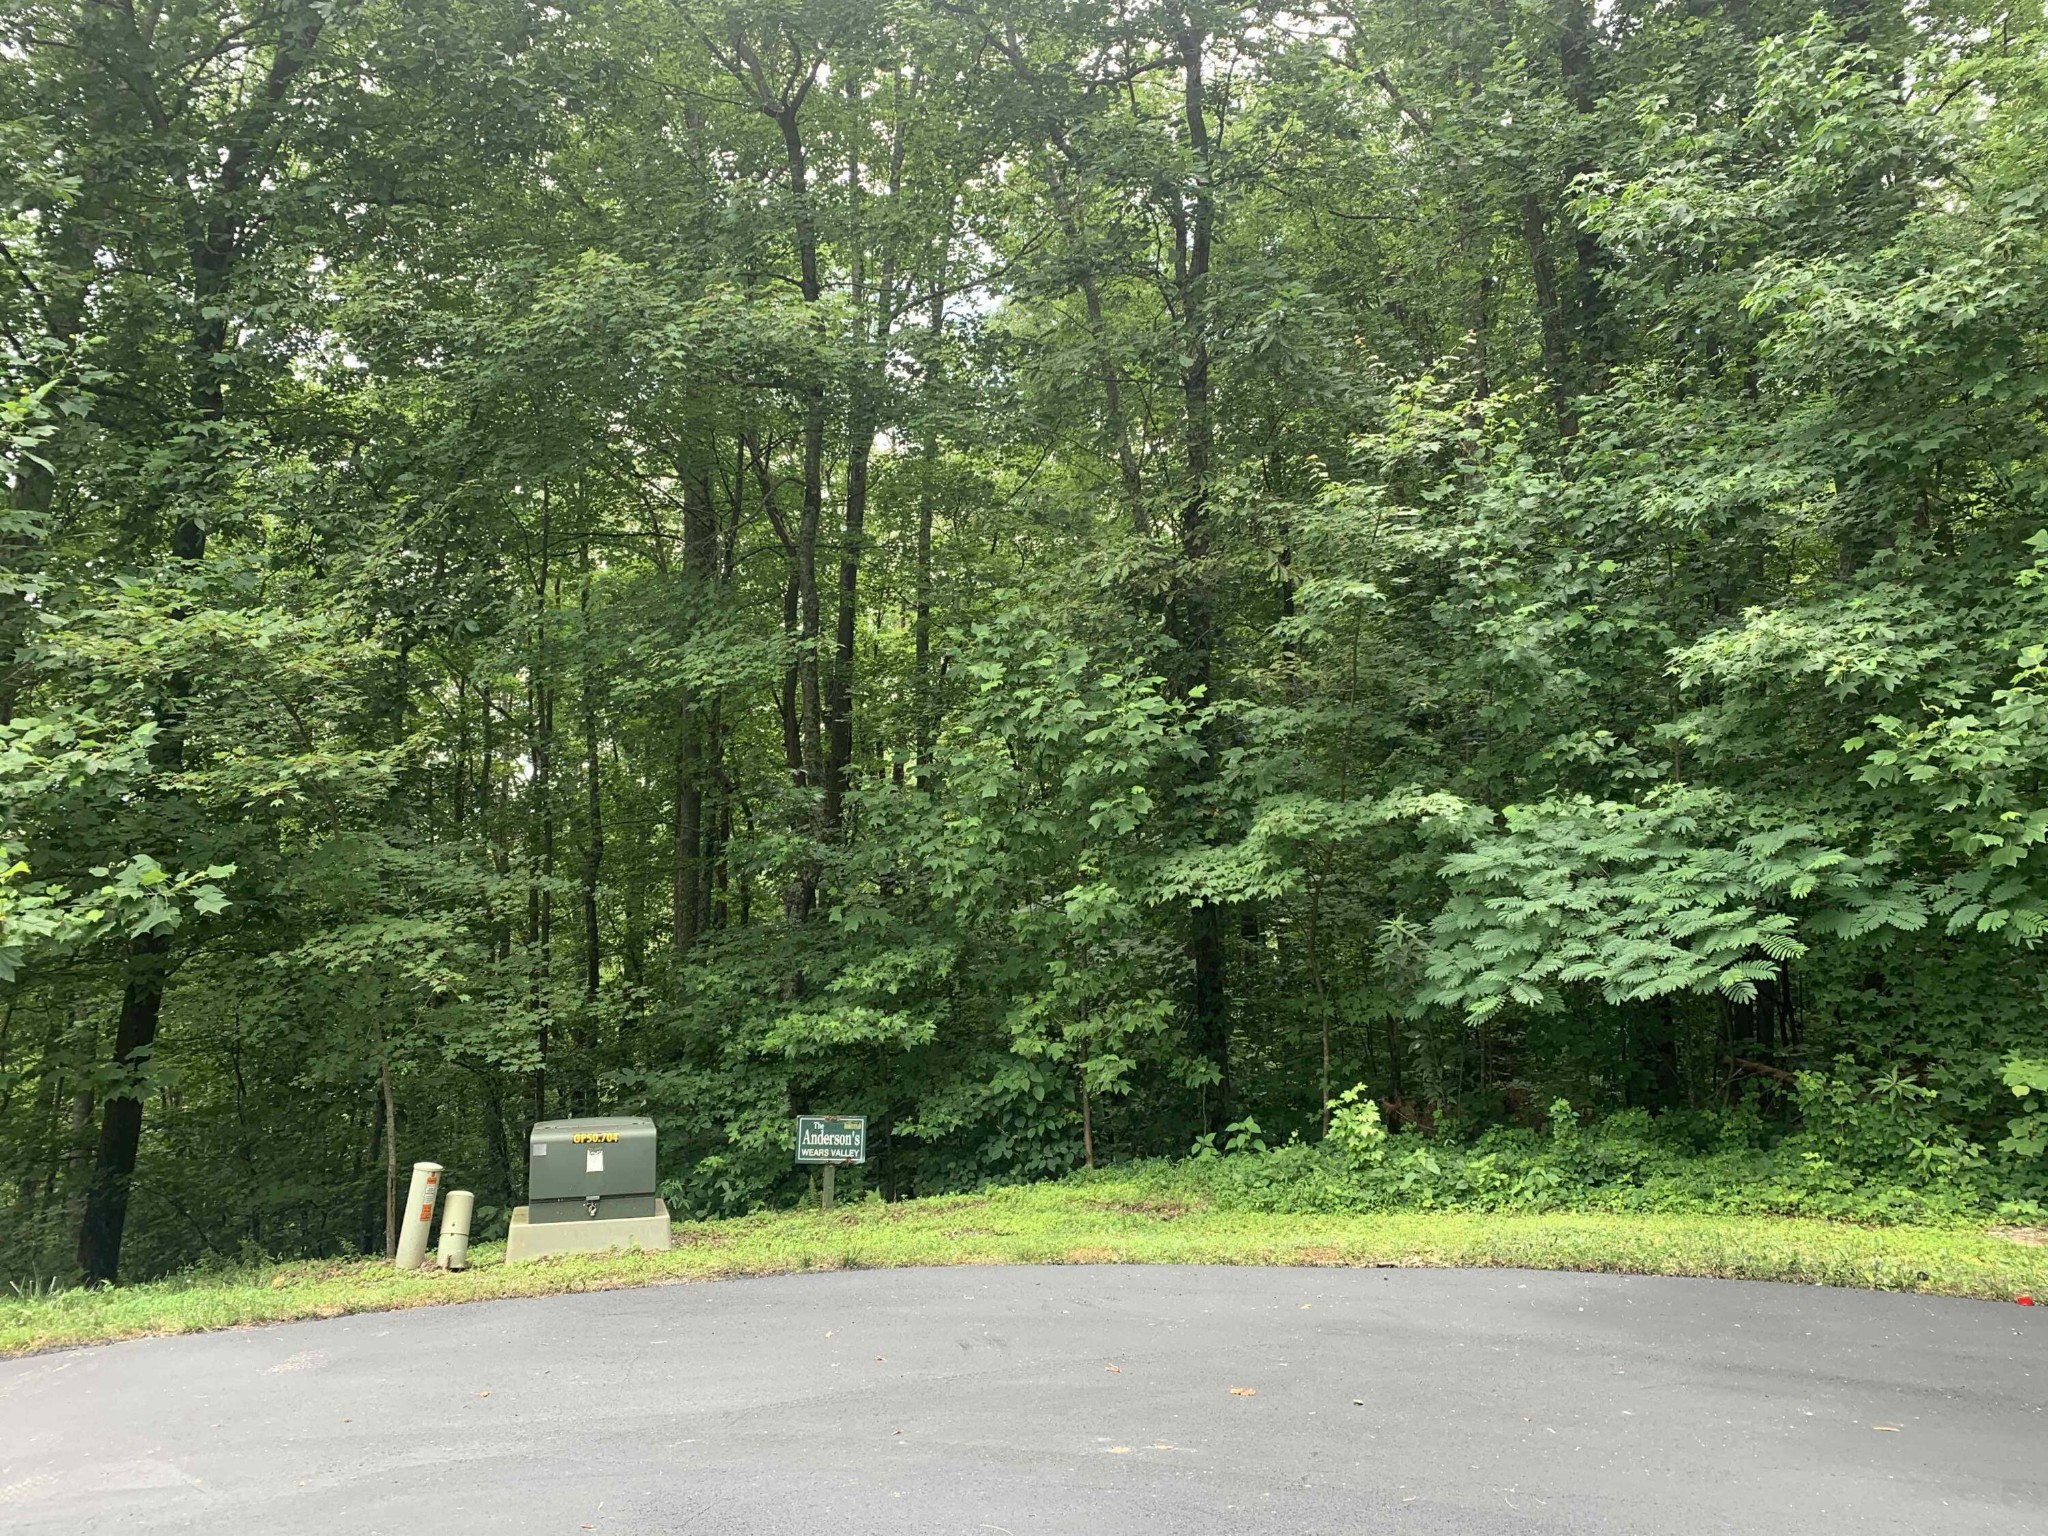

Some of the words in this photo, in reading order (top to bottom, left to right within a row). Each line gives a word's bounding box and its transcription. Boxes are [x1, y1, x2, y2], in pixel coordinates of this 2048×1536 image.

[813, 1121, 825, 1129] The
[802, 1129, 861, 1146] Anderson's
[801, 1148, 830, 1157] WEARS
[831, 1149, 860, 1157] VALLEY
